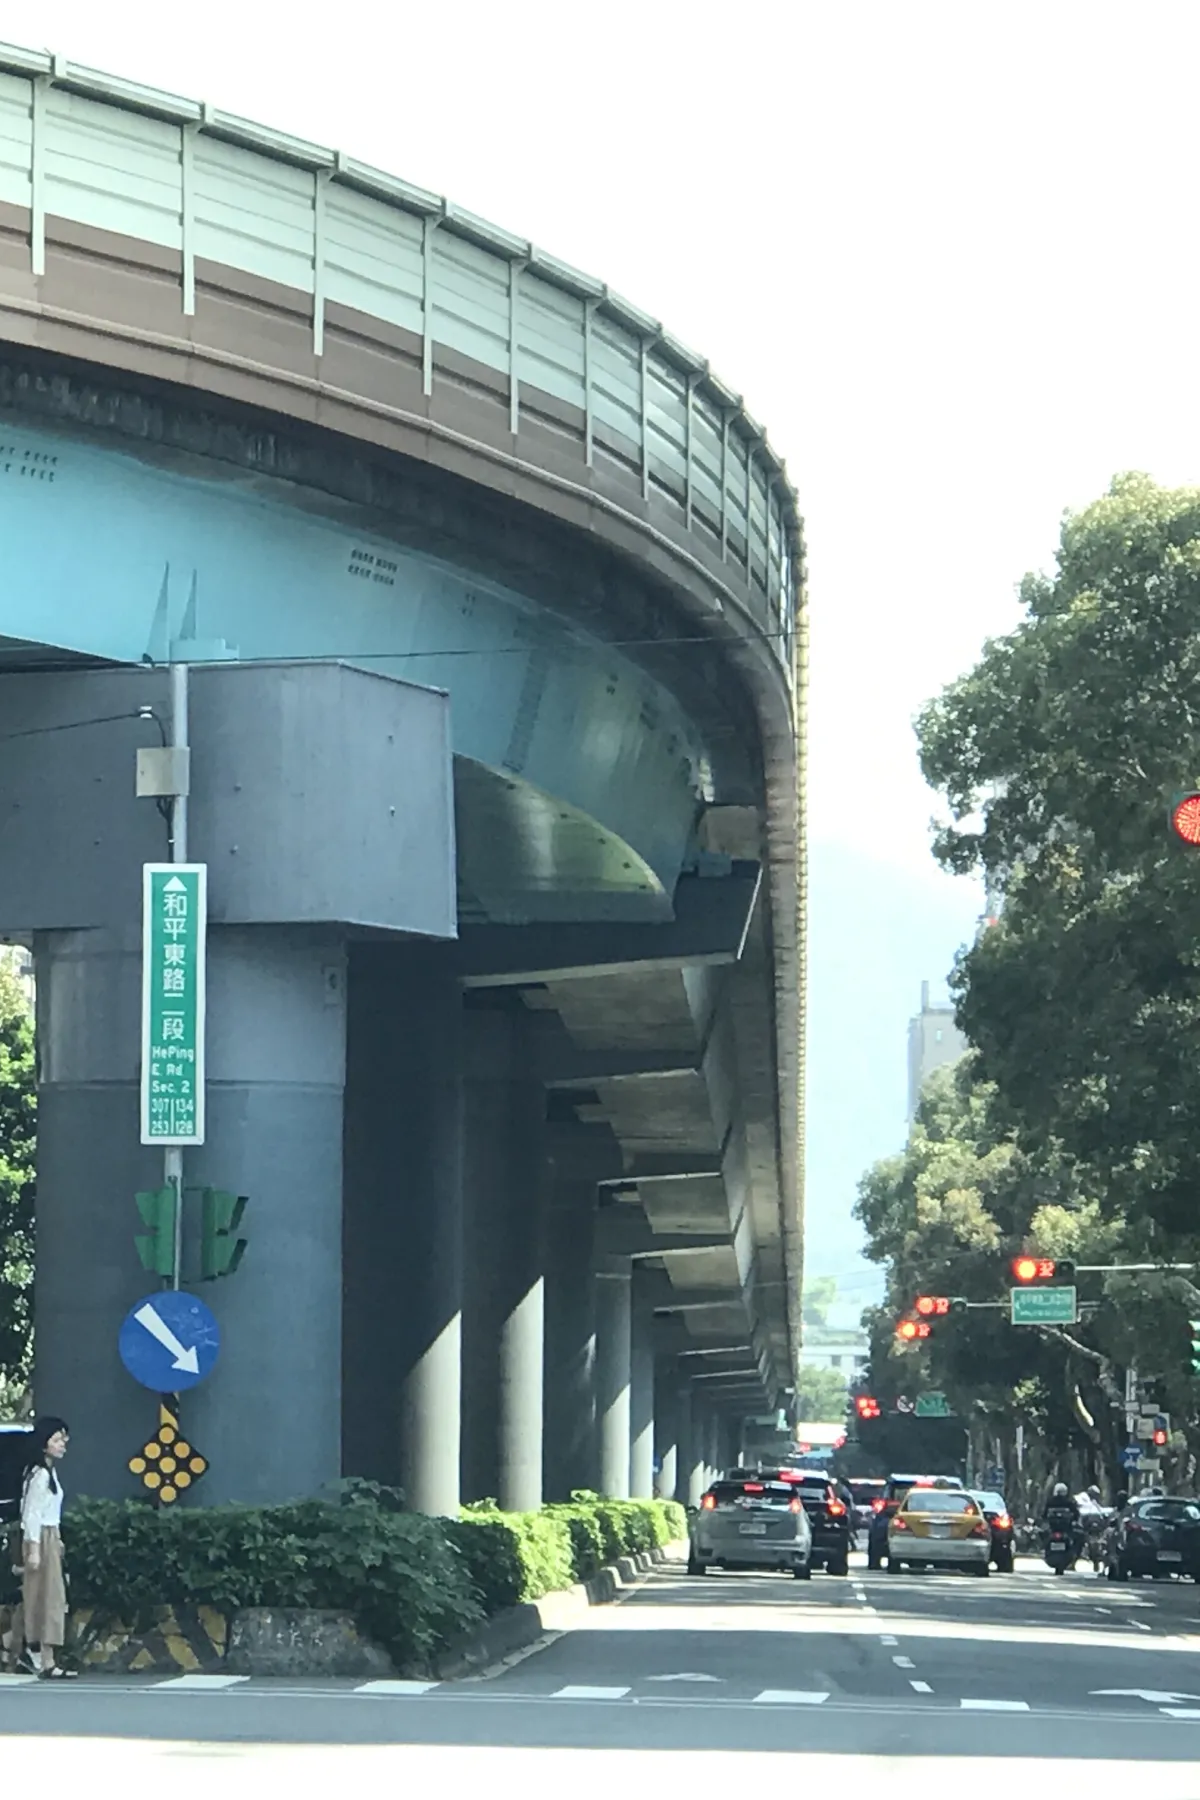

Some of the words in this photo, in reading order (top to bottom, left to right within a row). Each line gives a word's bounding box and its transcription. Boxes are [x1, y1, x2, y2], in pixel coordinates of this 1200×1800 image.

[162, 893, 188, 1041] 和平東路二段
[152, 1045, 194, 1063] HePing
[181, 1080, 190, 1093] 2
